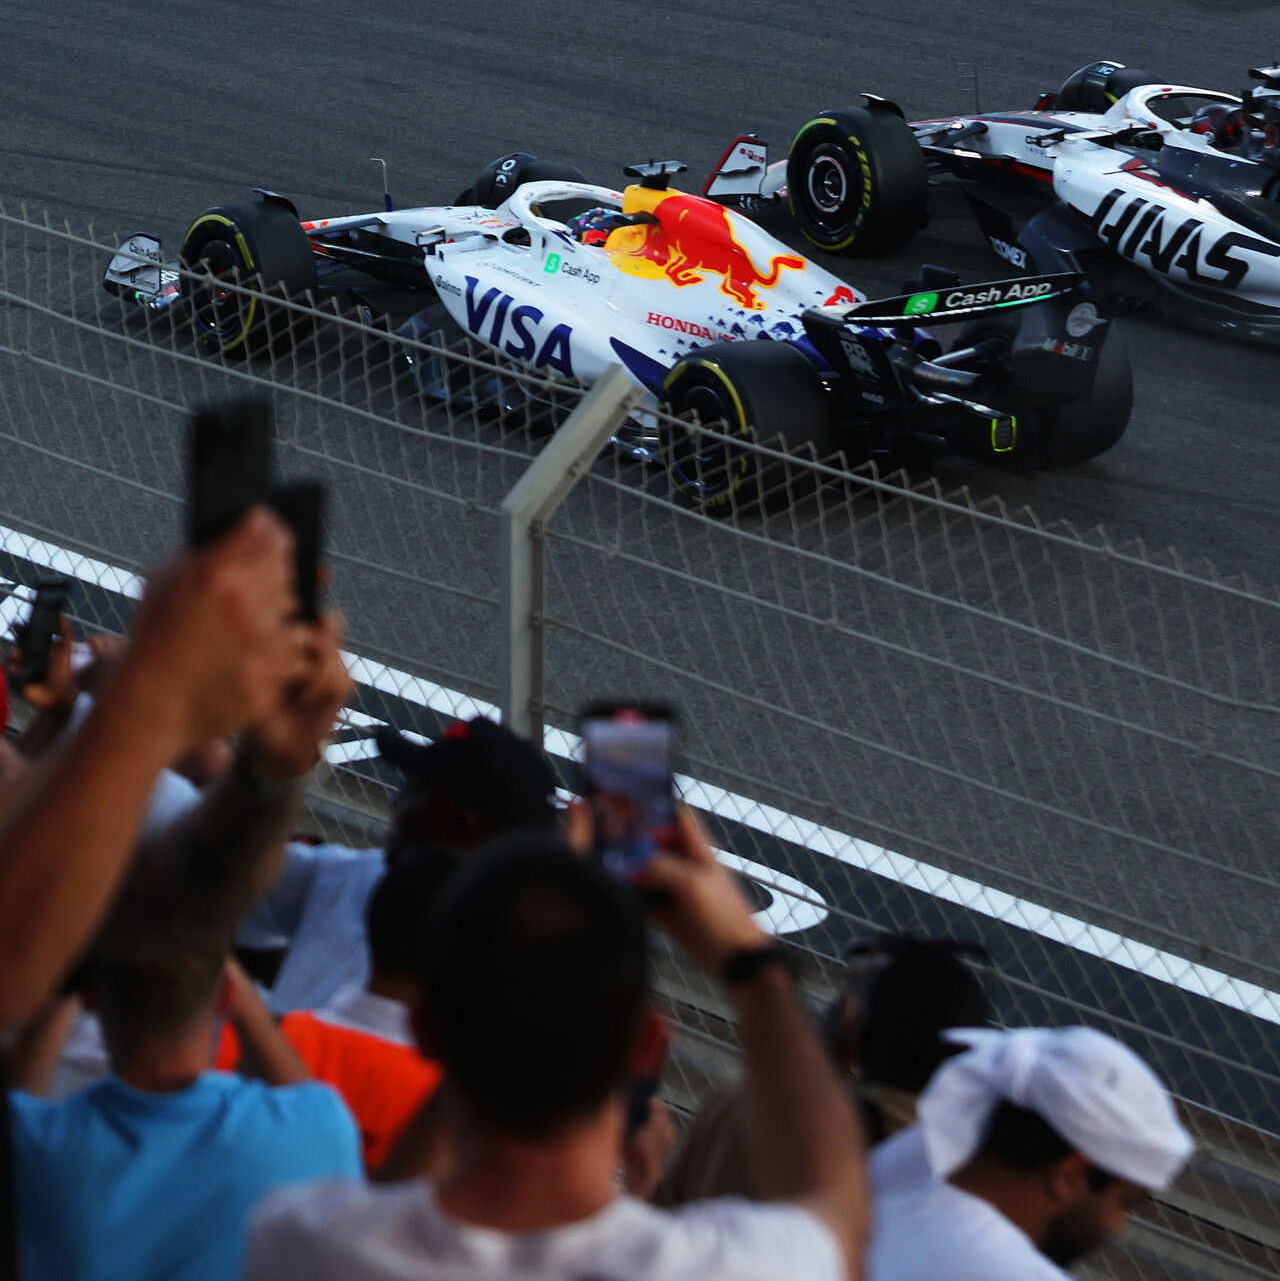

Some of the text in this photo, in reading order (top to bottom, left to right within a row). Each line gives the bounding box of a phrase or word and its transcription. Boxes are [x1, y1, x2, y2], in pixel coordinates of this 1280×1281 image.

[855, 150, 873, 209] ZERO
[560, 261, 601, 285] Cash App
[944, 281, 1052, 309] Cash App
[463, 275, 574, 378] VISA
[646, 311, 715, 340] HONDA
